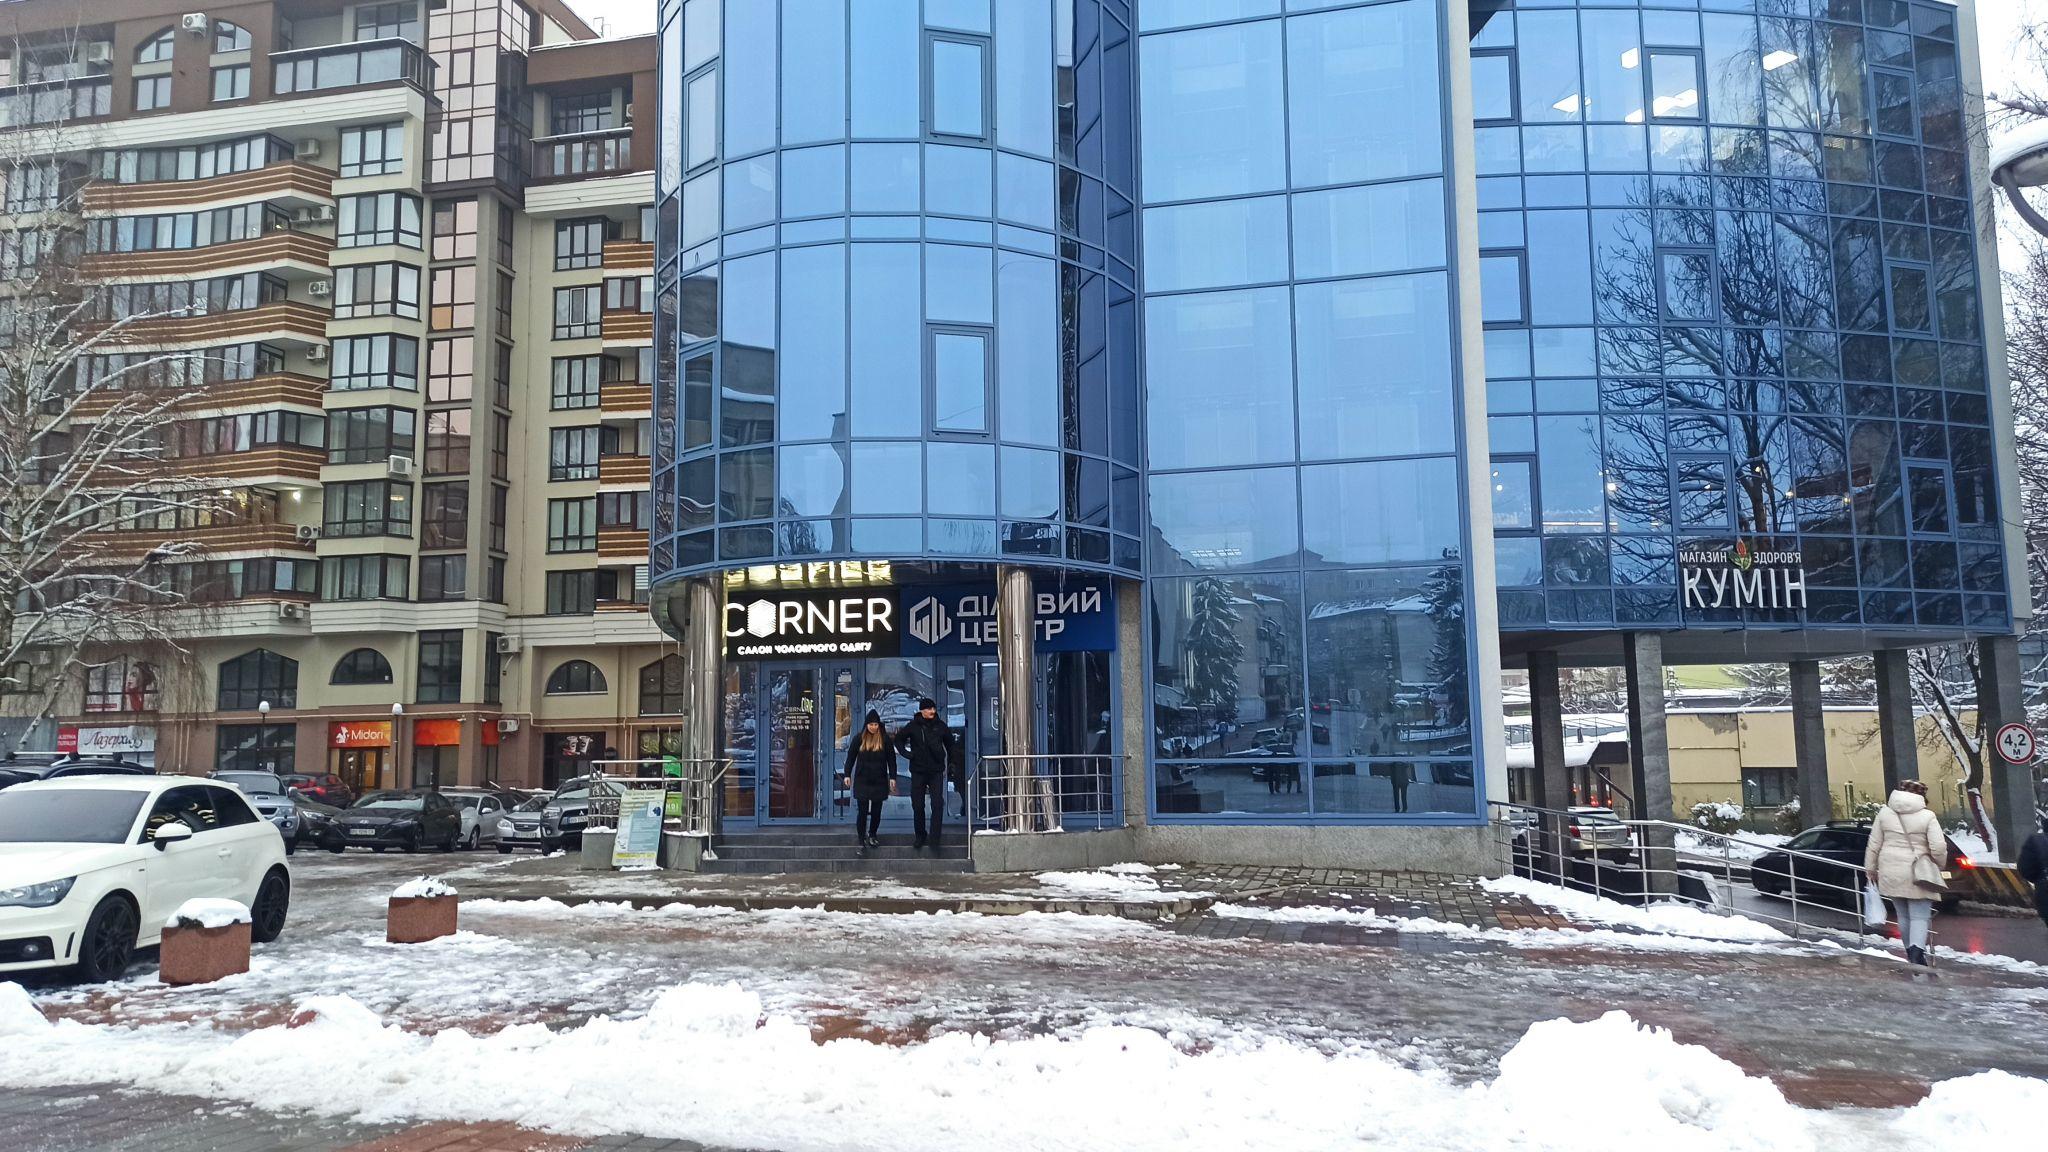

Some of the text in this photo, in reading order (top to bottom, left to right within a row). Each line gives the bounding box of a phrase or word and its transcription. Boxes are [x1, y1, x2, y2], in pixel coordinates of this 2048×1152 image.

[1679, 551, 1802, 564] МАГАЗИН ЗДОРОВ'Я
[1682, 567, 1807, 609] КУМІН
[956, 586, 1101, 617] ДІВИЙ
[726, 597, 893, 638] CORNER
[960, 619, 1065, 646] ЦЕР
[737, 641, 872, 656] САЛОН ЧОЛОВІЧОГО ОДЯГУ
[351, 729, 384, 740] Midori
[2004, 734, 2026, 748] 4,2
